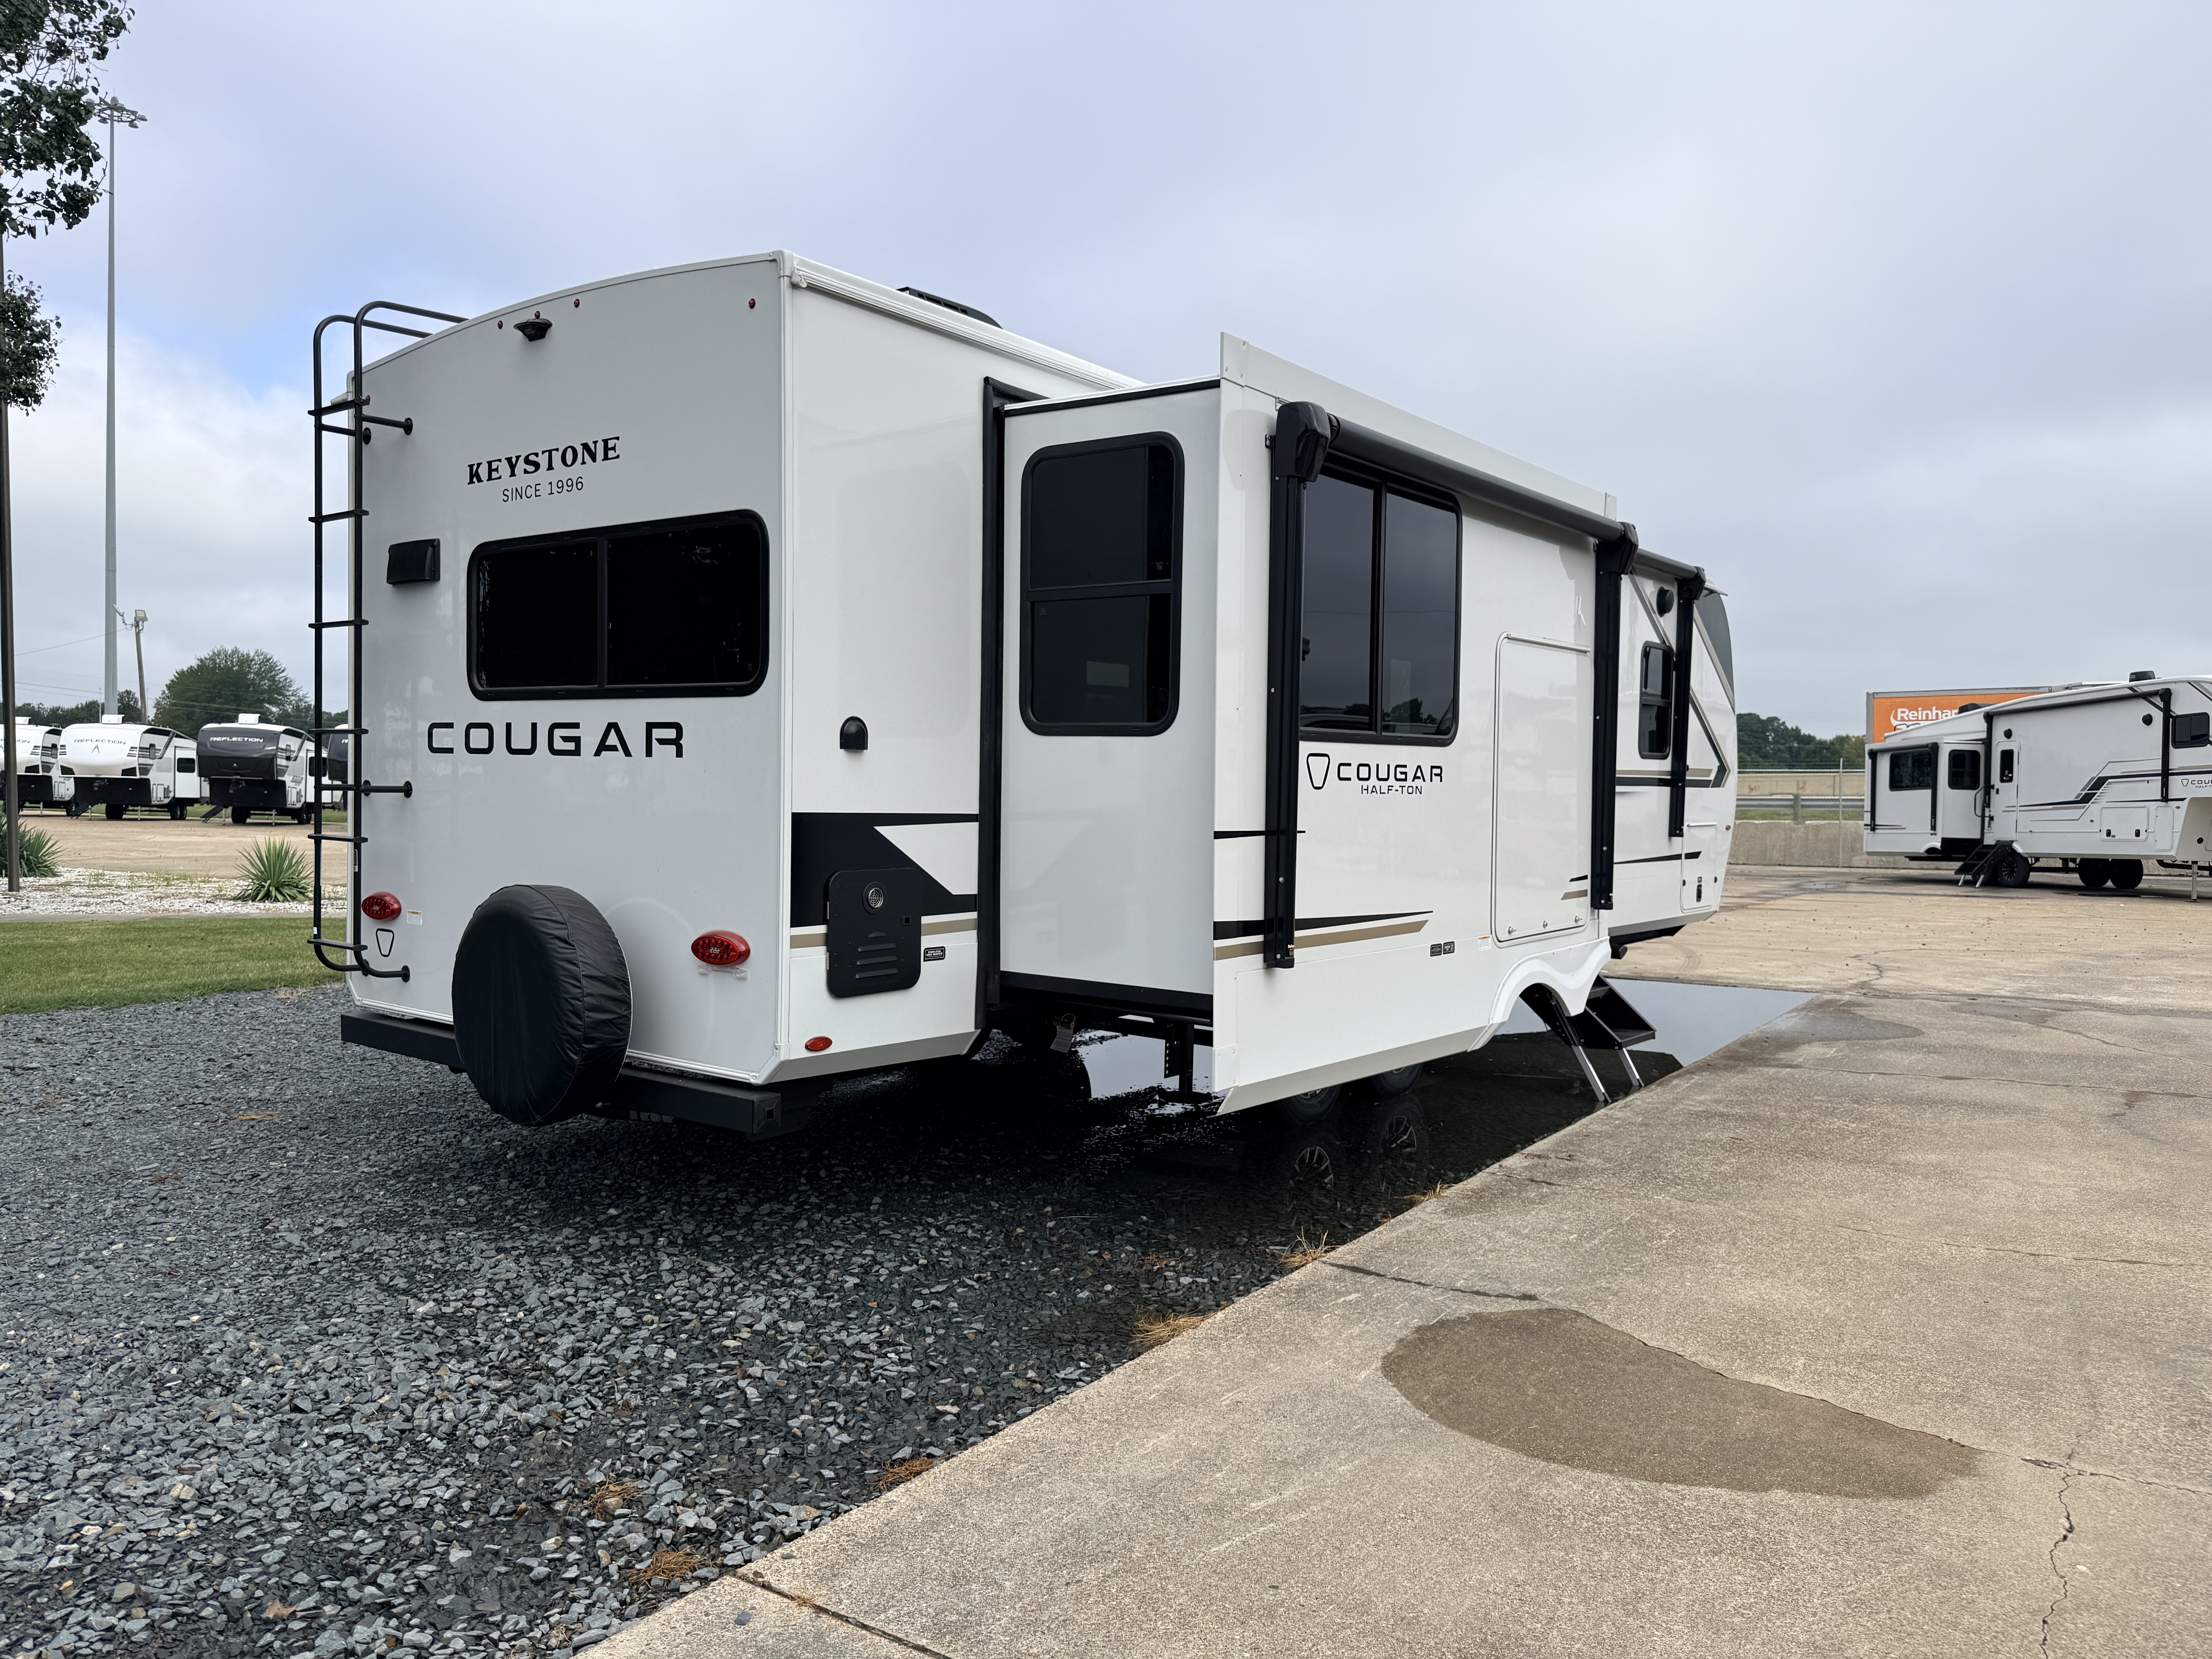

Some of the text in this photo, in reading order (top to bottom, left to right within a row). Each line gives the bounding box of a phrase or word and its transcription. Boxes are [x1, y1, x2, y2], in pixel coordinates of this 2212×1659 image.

[467, 436, 620, 485] KEYSTONE
[502, 476, 584, 502] SINCE 1996
[1897, 706, 1959, 721] Reinhar
[427, 721, 684, 758] COUGAR
[1337, 763, 1443, 783] COUGAR
[1361, 785, 1422, 795] HALF-TON
